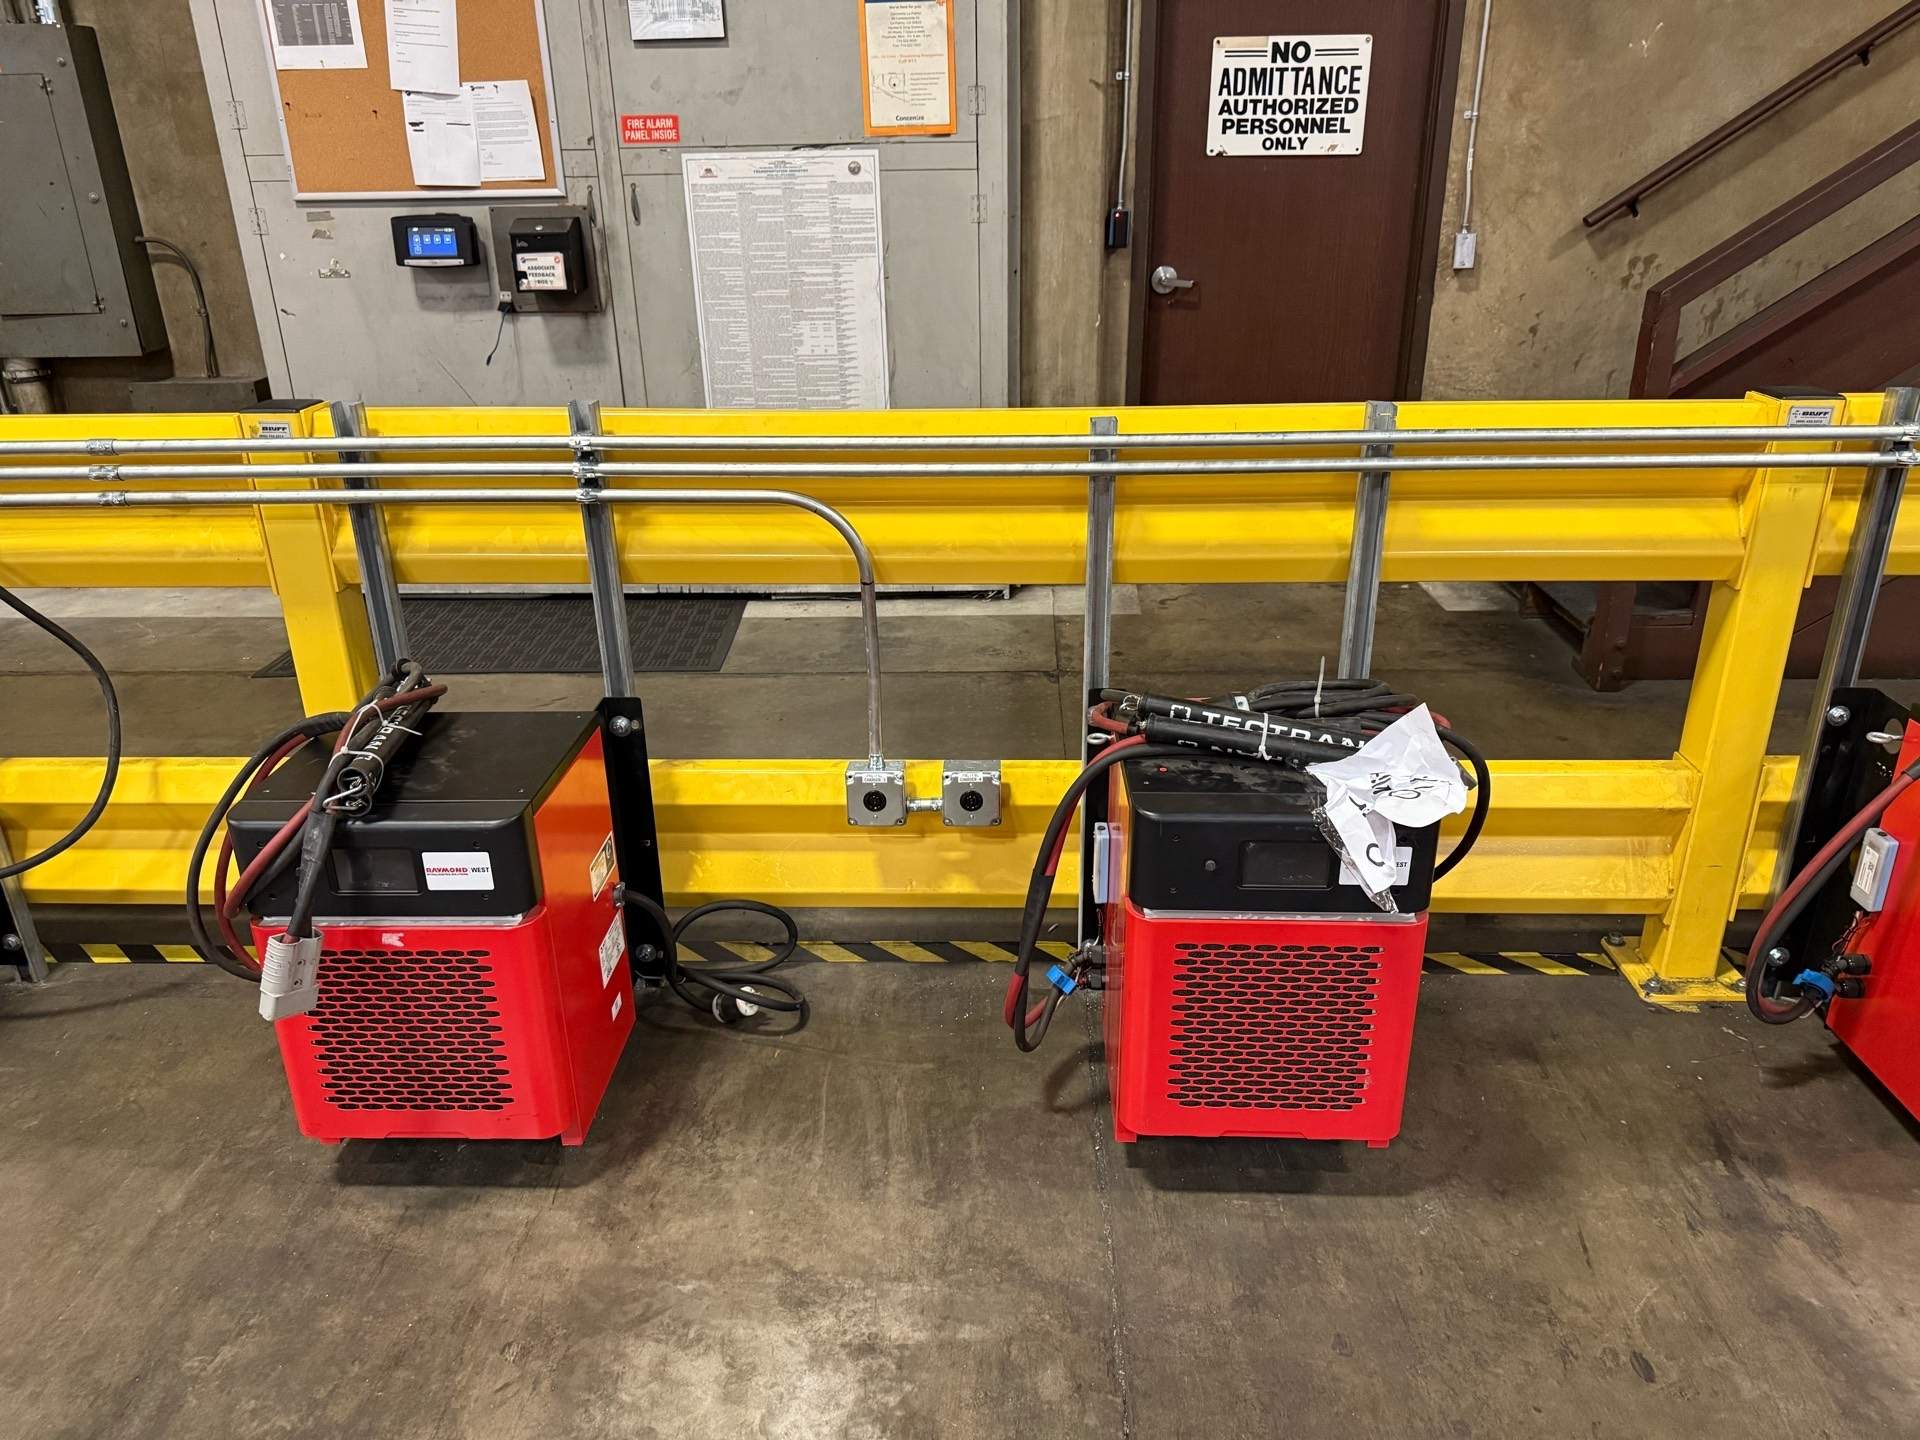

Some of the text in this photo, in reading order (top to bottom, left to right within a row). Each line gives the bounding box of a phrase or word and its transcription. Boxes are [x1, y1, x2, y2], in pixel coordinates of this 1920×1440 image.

[1271, 41, 1311, 63] NO
[1218, 66, 1362, 96] ADMITTANCE
[1218, 98, 1358, 115] AUTHORIZED
[627, 118, 673, 129] FIRE ALARM
[1221, 117, 1351, 134] PERSONNEL
[625, 129, 678, 140] PANEL INSIDE
[1262, 137, 1308, 150] ONLY
